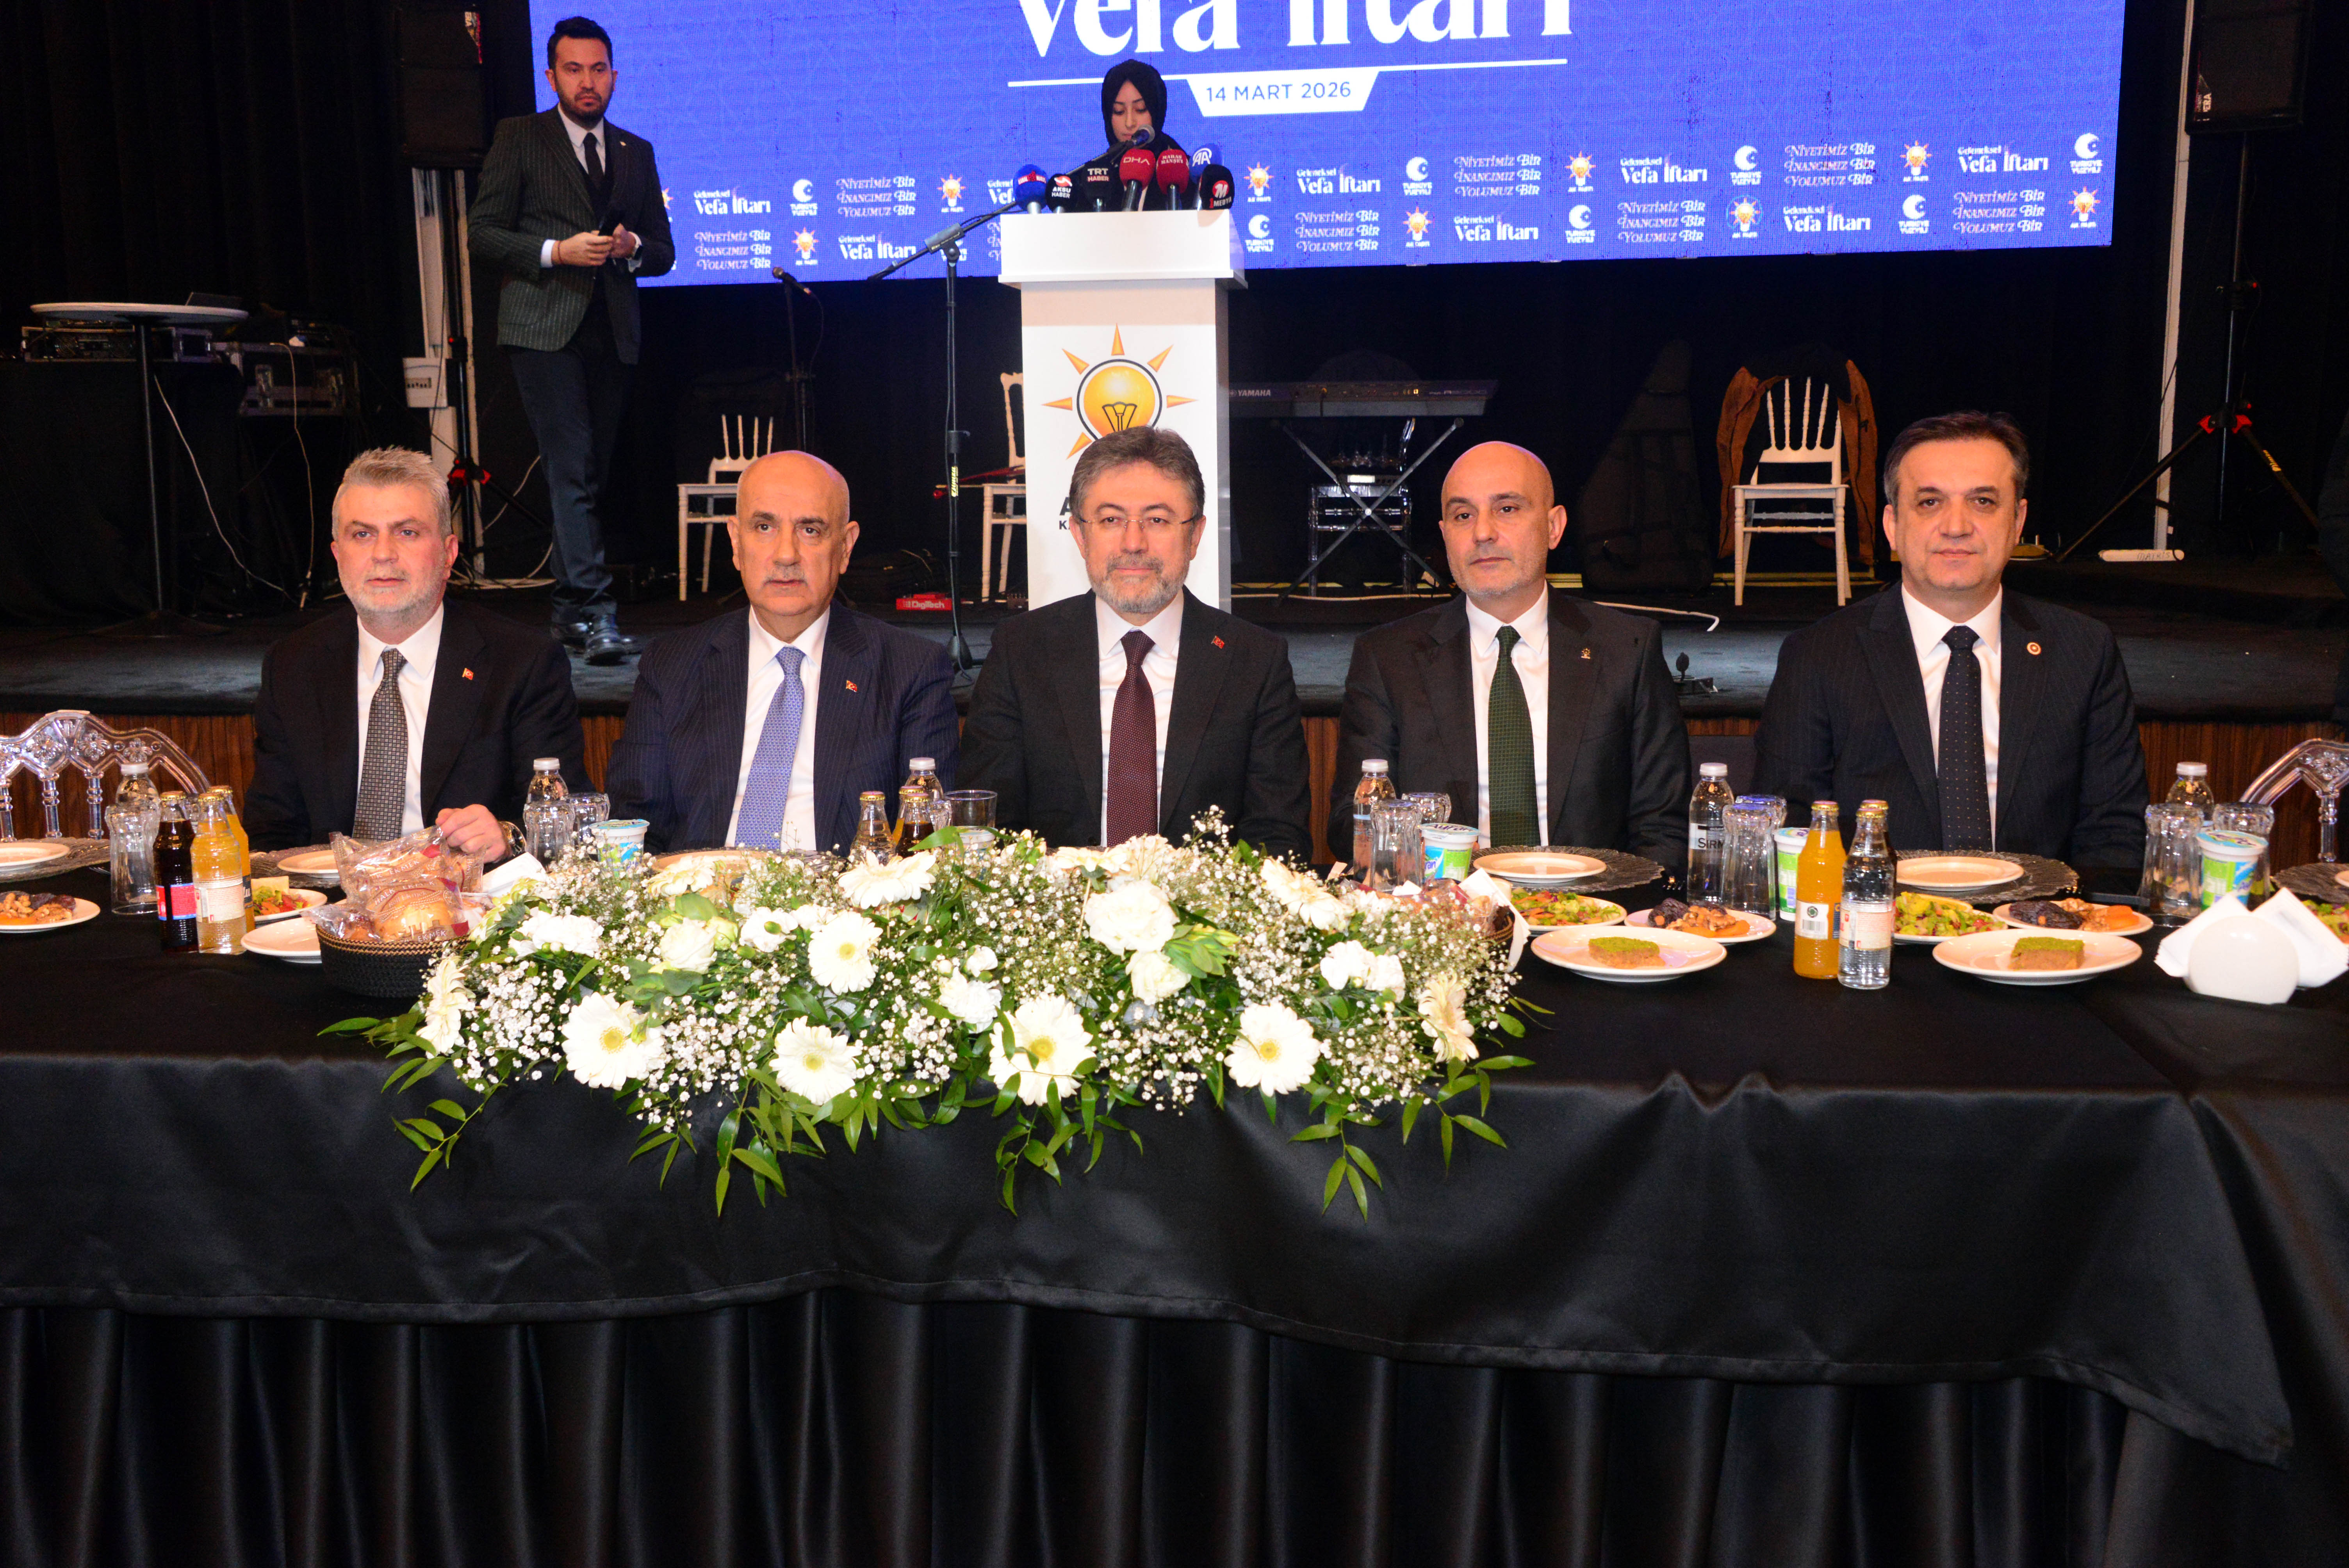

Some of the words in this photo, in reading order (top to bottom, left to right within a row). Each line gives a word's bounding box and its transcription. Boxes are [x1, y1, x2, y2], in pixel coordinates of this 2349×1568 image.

[1206, 87, 1226, 103] 14
[1234, 83, 1292, 102] MART
[1301, 81, 1351, 99] 2026
[1123, 157, 1150, 166] DHA
[1192, 150, 1211, 167] AA
[1959, 155, 1996, 173] Vefa
[1622, 166, 1658, 184] Vefa
[1297, 177, 1333, 194] Vefa
[989, 188, 1015, 204] Vef
[695, 199, 728, 215] Vefa
[1784, 215, 1821, 232] Vefa
[1455, 225, 1490, 241] Vefa
[839, 244, 873, 259] Vefa
[912, 600, 945, 609] DigiTech
[389, 860, 419, 875] EKMEK
[374, 888, 395, 905] HALK
[418, 930, 446, 942] EKMEK
